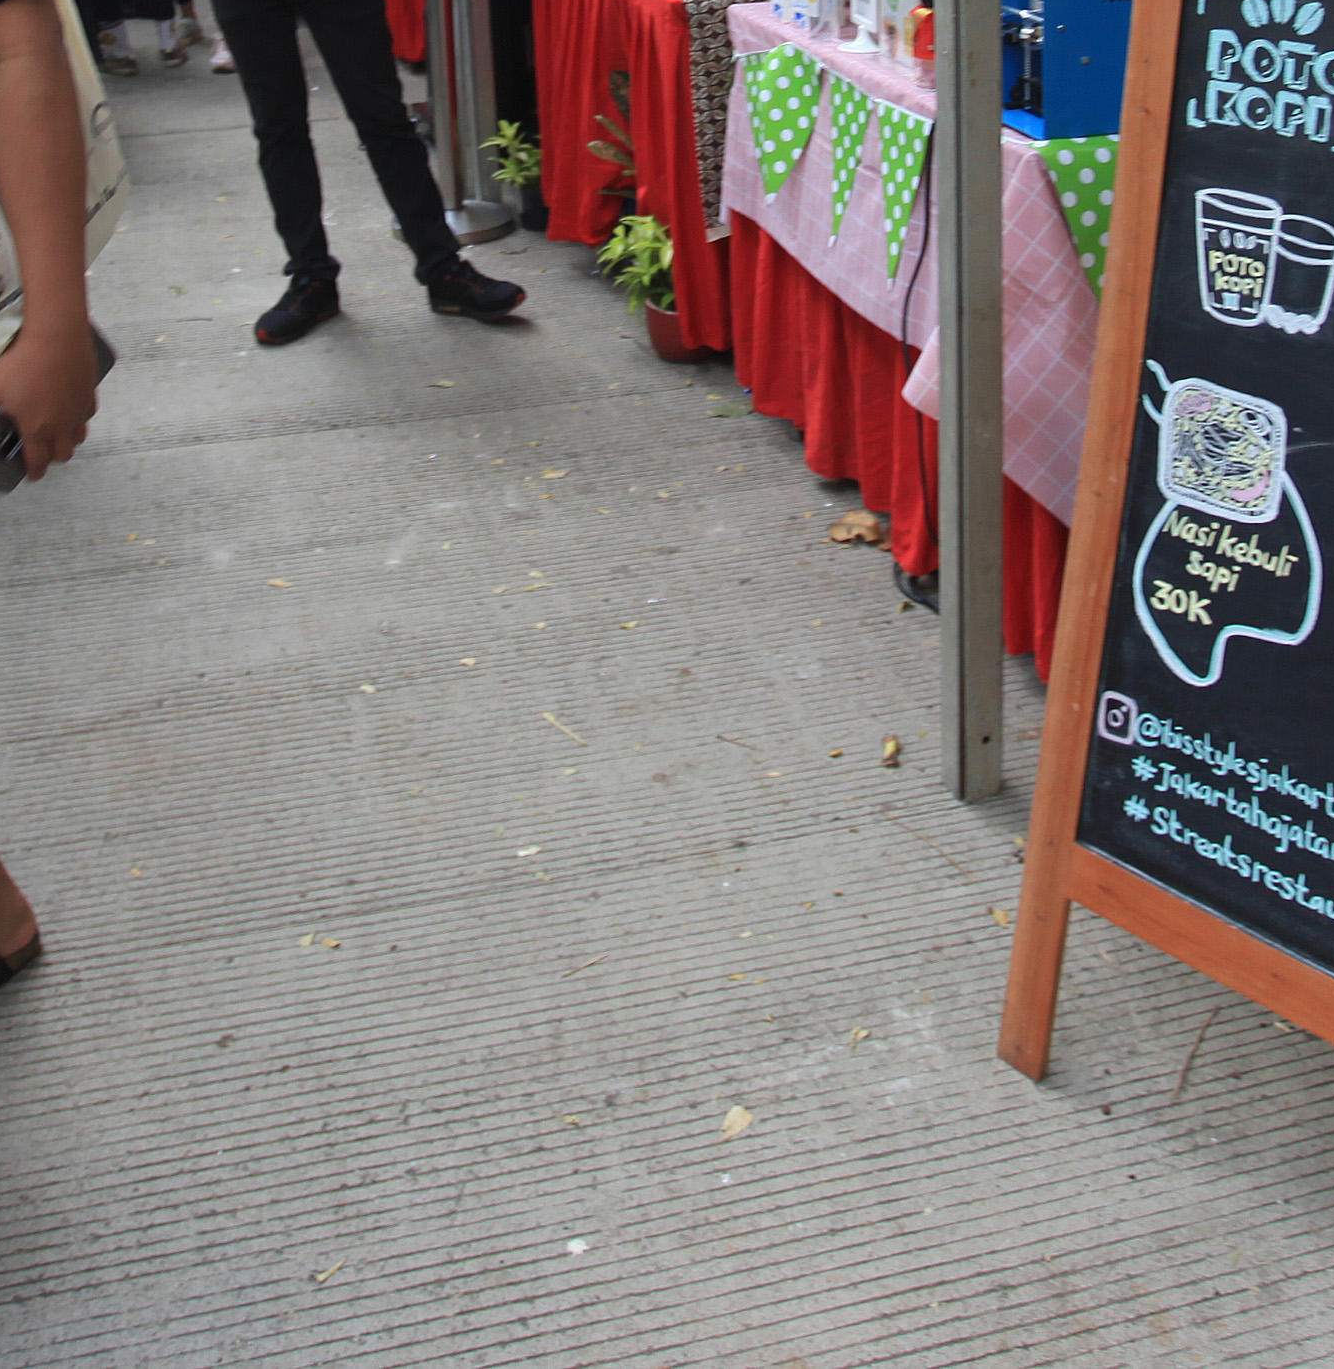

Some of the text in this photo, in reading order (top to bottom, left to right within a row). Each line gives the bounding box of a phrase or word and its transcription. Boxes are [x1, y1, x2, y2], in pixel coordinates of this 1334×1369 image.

[1205, 80, 1333, 143] KOPI
[1162, 510, 1220, 547] Nasi
[1150, 580, 1212, 625] 30K
